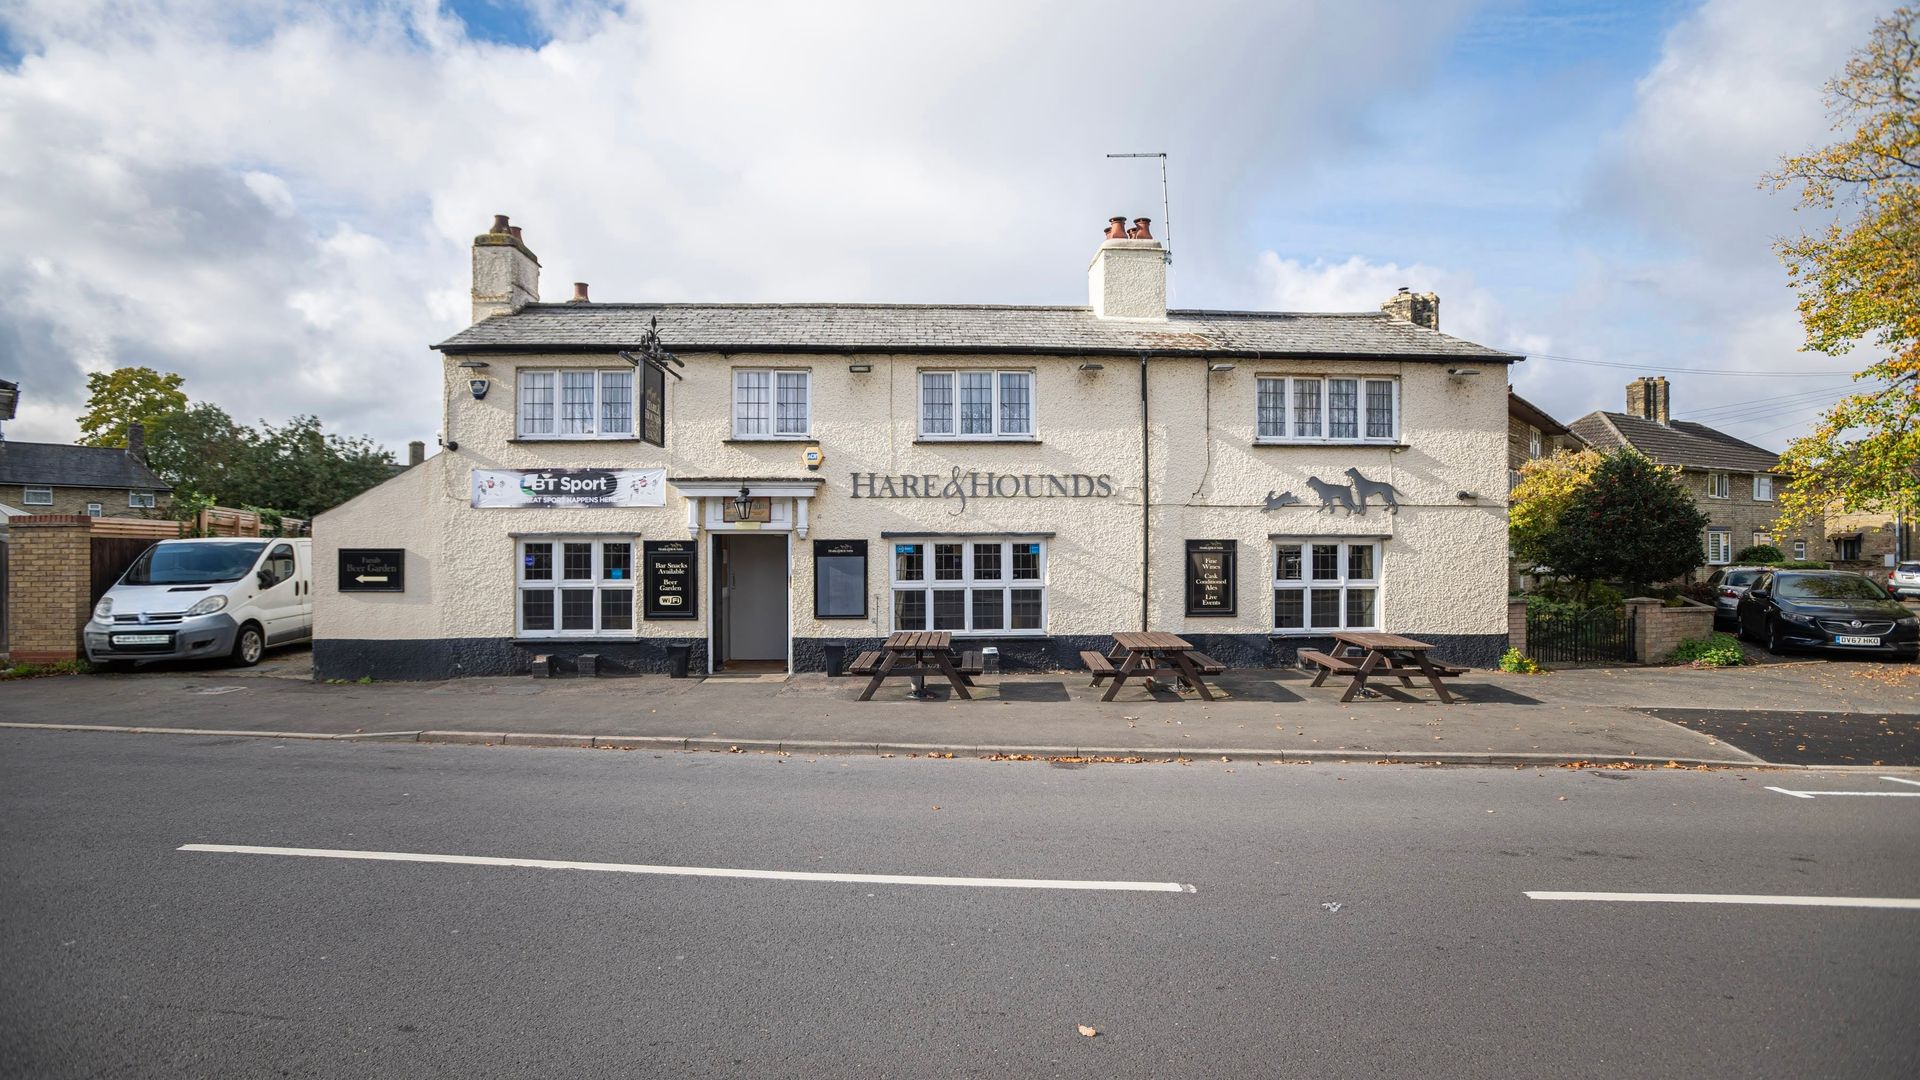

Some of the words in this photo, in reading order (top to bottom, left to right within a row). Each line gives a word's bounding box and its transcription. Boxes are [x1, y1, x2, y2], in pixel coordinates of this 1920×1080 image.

[532, 476, 558, 490] BT
[560, 476, 607, 493] Sport
[850, 472, 943, 498] HARE
[943, 466, 975, 516] &
[971, 472, 1112, 498] HOUNDS
[346, 563, 366, 572] Beer
[367, 563, 397, 572] Garden
